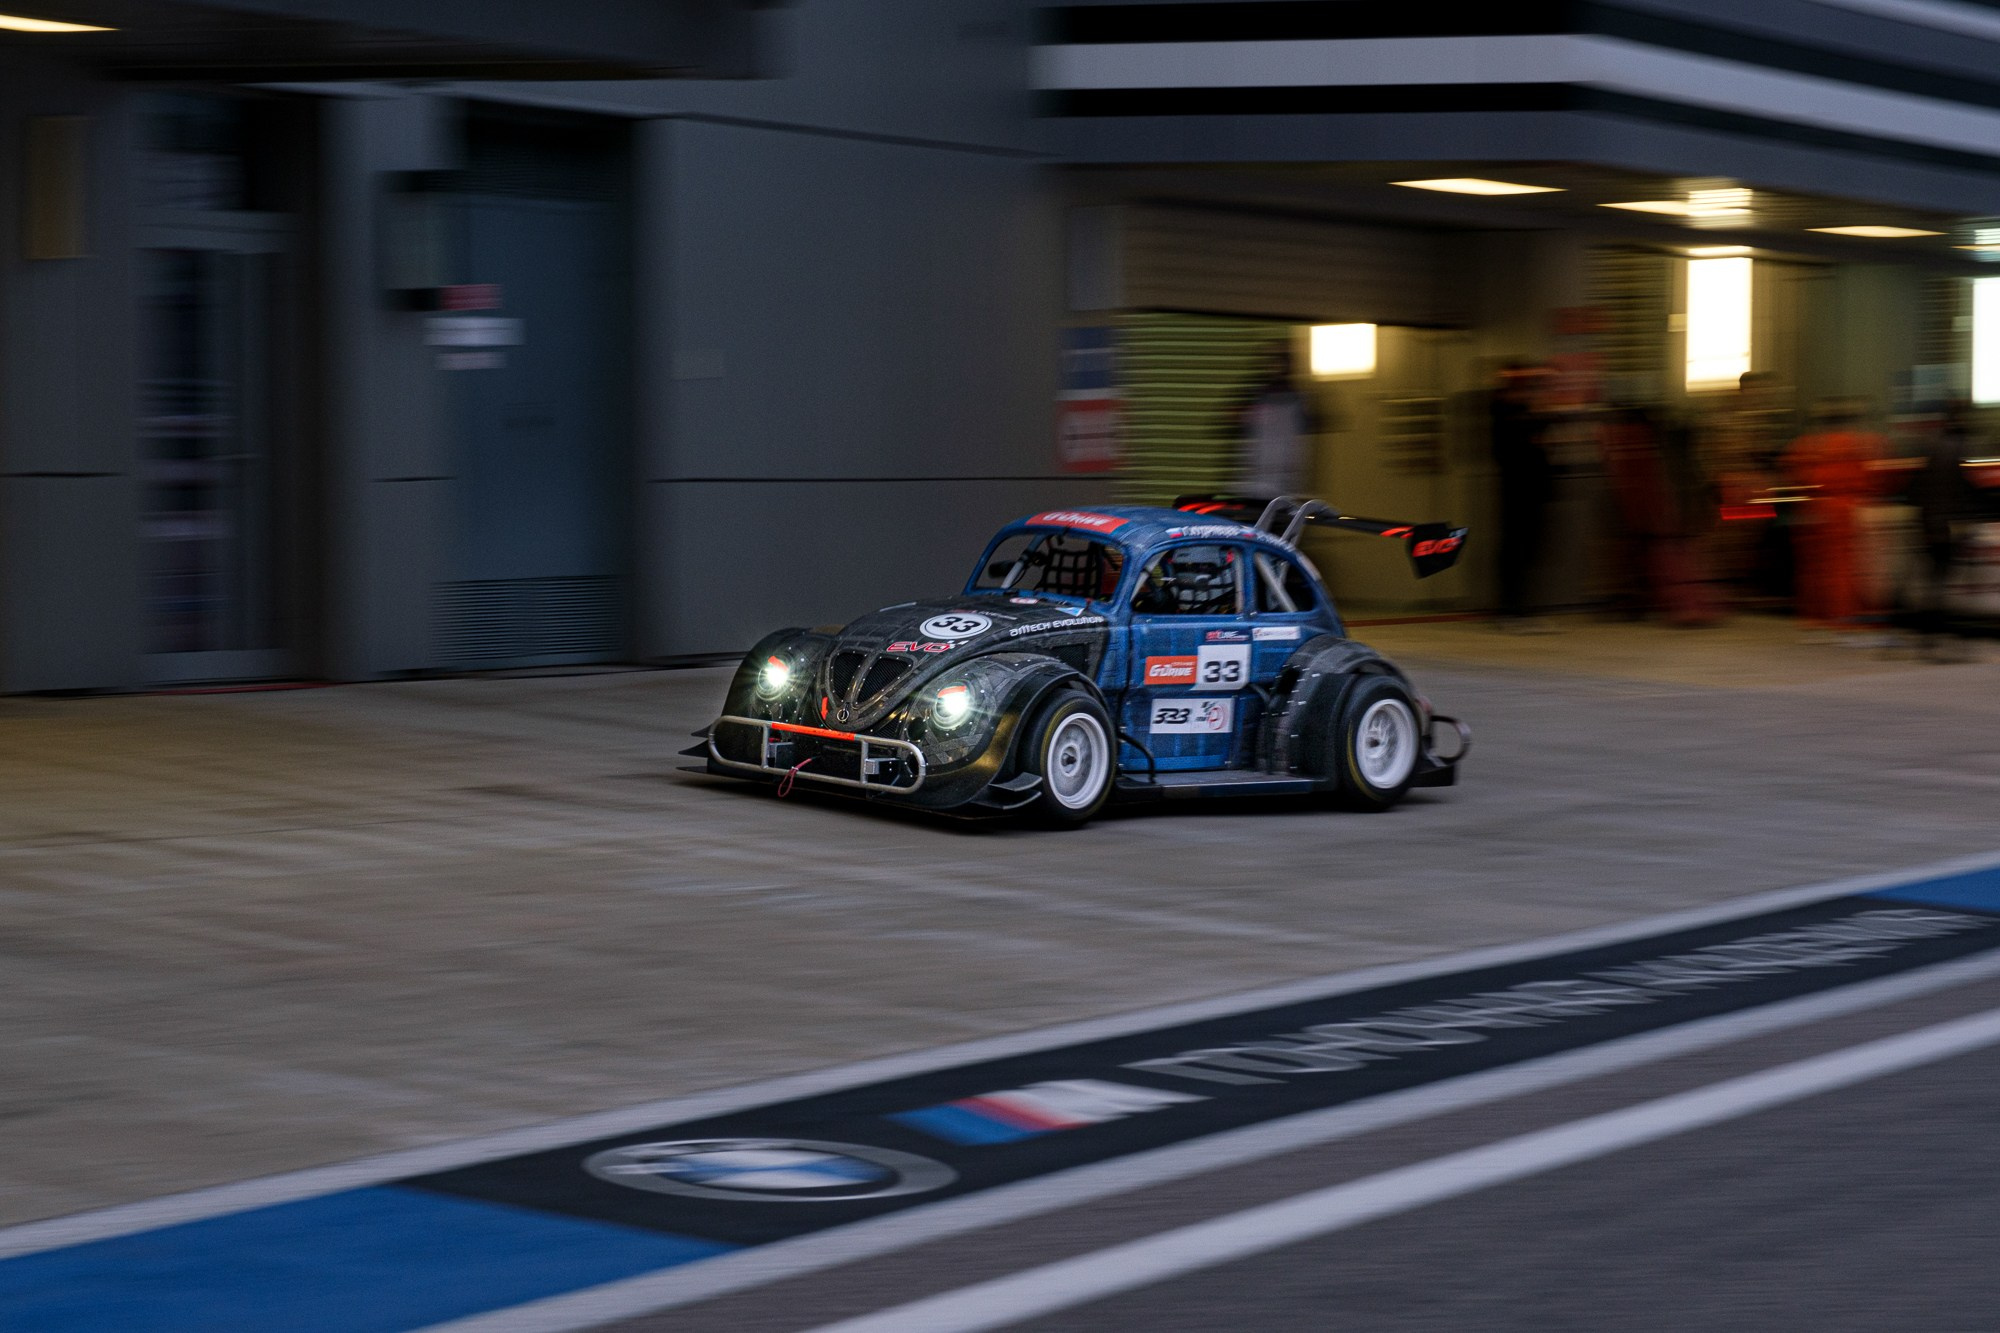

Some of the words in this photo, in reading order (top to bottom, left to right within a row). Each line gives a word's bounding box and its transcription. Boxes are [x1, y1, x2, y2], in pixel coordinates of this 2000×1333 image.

[932, 616, 981, 633] 33
[886, 641, 951, 653] EVO
[1203, 660, 1240, 683] 33
